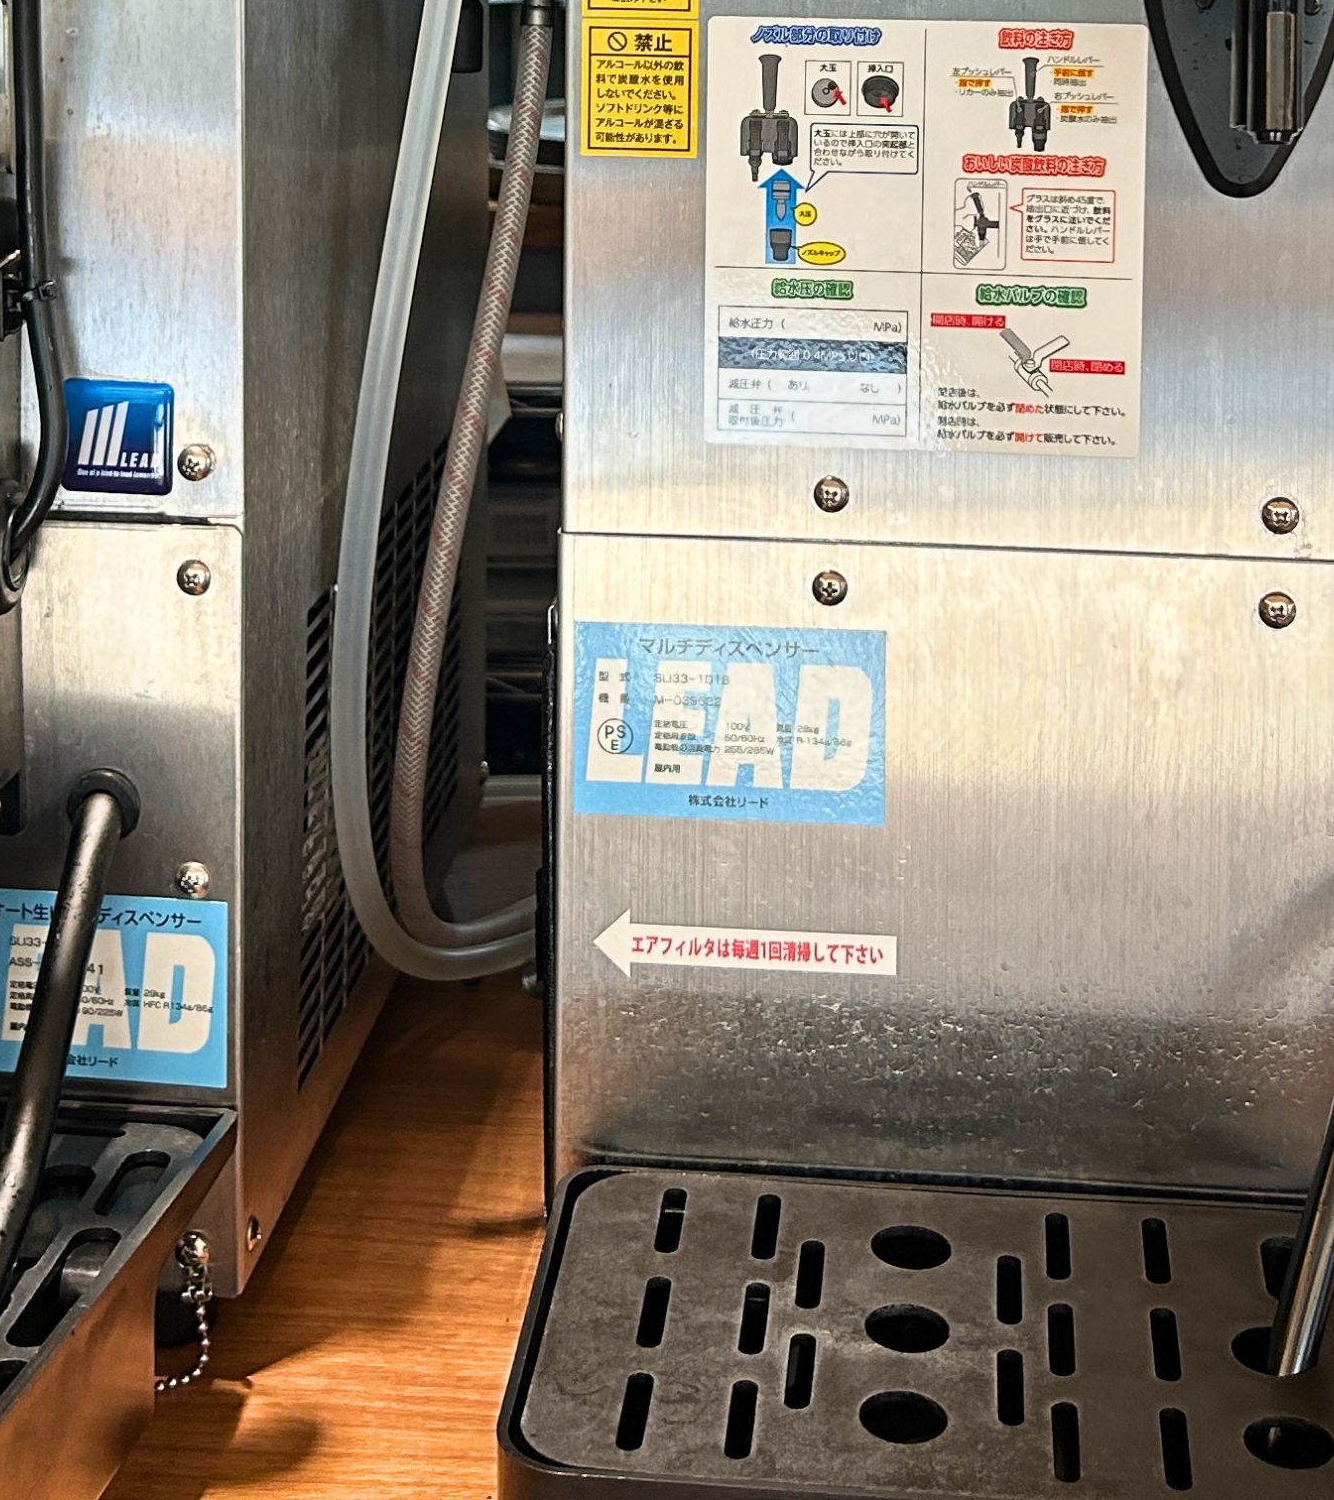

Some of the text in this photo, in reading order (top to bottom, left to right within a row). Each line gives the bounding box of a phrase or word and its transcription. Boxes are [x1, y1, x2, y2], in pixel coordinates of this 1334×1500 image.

[634, 33, 673, 52] 禁止
[751, 26, 882, 45] ノズル部分の取り付け
[999, 28, 1074, 50] 飲料の注ぎ方
[596, 59, 684, 71] アルコール以外の飲
[596, 74, 684, 86] 料で炭酸水を使用
[596, 88, 676, 100] しないでください。
[596, 103, 683, 115] ソフトドリンク等に
[595, 118, 683, 129] アルコールが混ざる
[638, 638, 819, 659] マルチディスペンサー
[585, 658, 874, 792] LEAD
[688, 793, 769, 809] 株式会社リード
[631, 934, 884, 965] エアフィルタは毎週1回清掃して下さい
